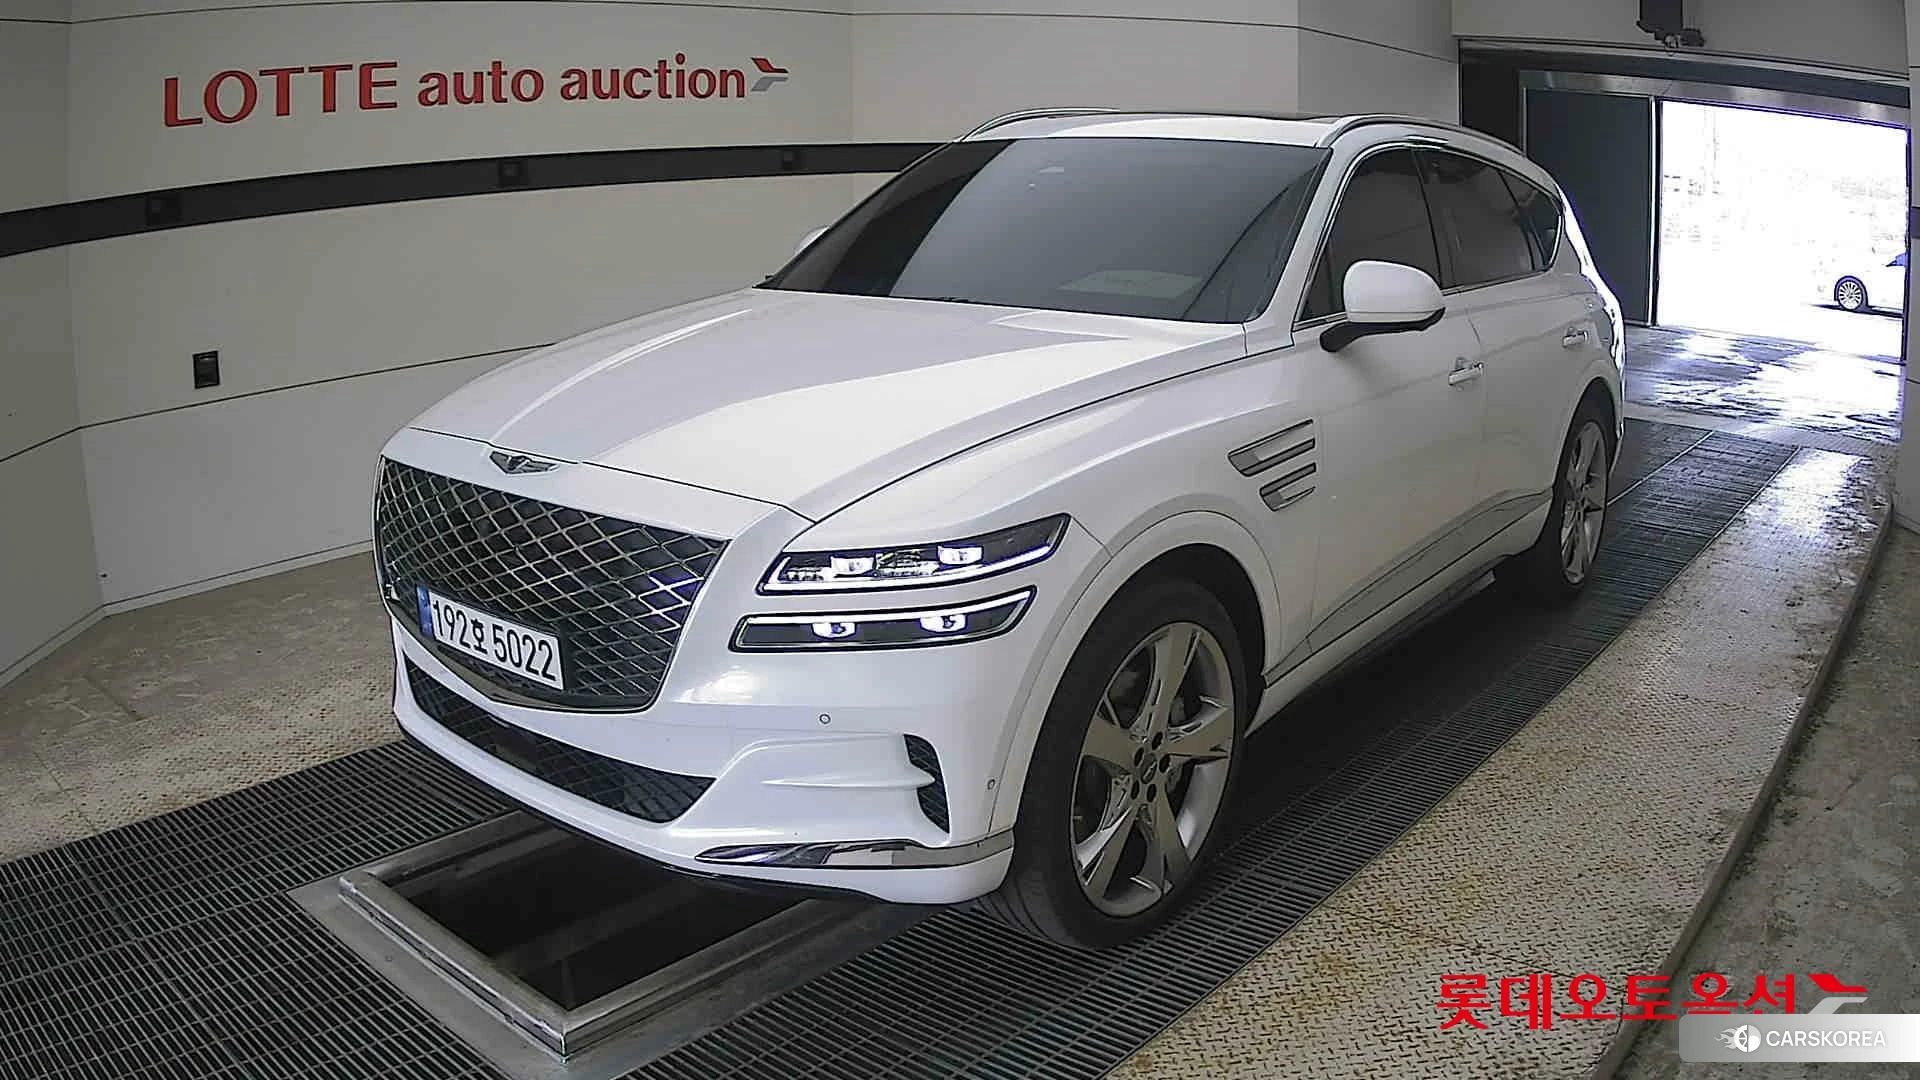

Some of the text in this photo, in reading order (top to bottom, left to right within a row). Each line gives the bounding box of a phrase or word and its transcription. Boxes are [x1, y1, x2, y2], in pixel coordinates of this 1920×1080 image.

[164, 53, 746, 128] LOTTE auto auction
[492, 623, 557, 682] 5022
